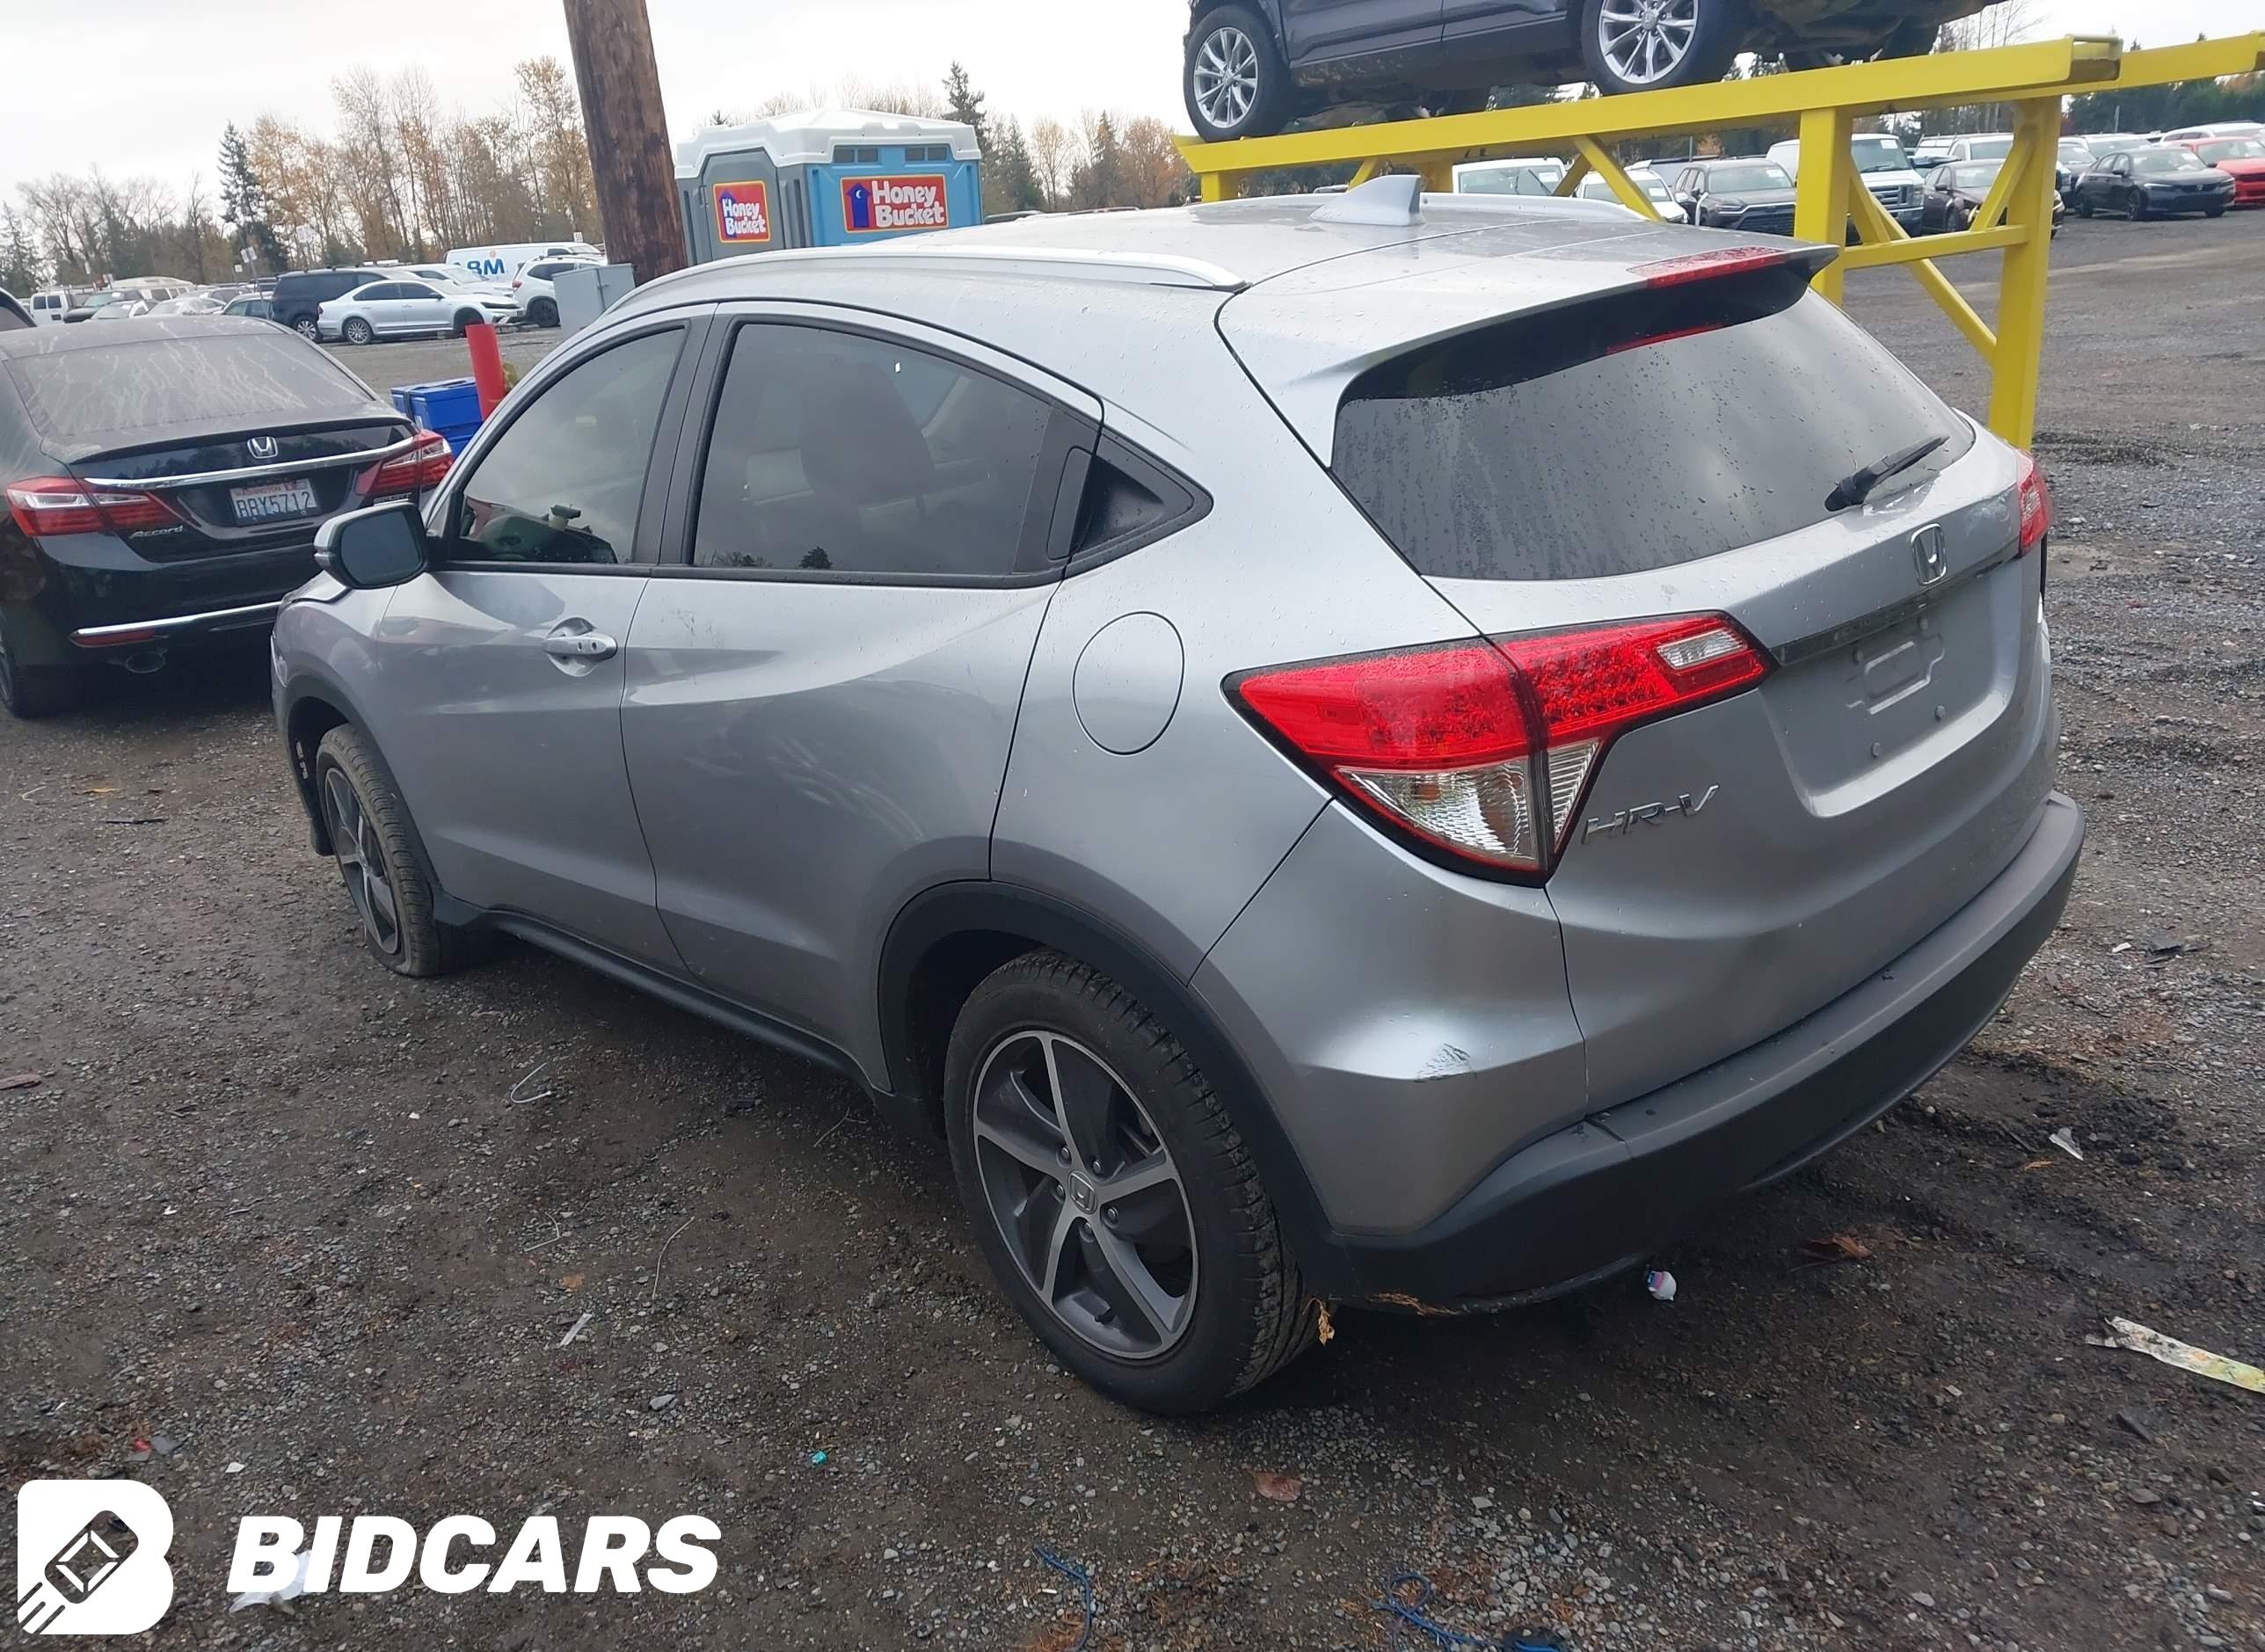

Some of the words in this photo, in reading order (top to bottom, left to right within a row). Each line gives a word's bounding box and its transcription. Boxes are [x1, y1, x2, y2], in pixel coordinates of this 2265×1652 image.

[871, 180, 936, 207] Honey
[722, 198, 760, 219] Honey
[875, 201, 944, 227] Bucket
[725, 215, 766, 235] Bucket
[454, 258, 505, 275] BM
[1582, 785, 1719, 844] HR-V
